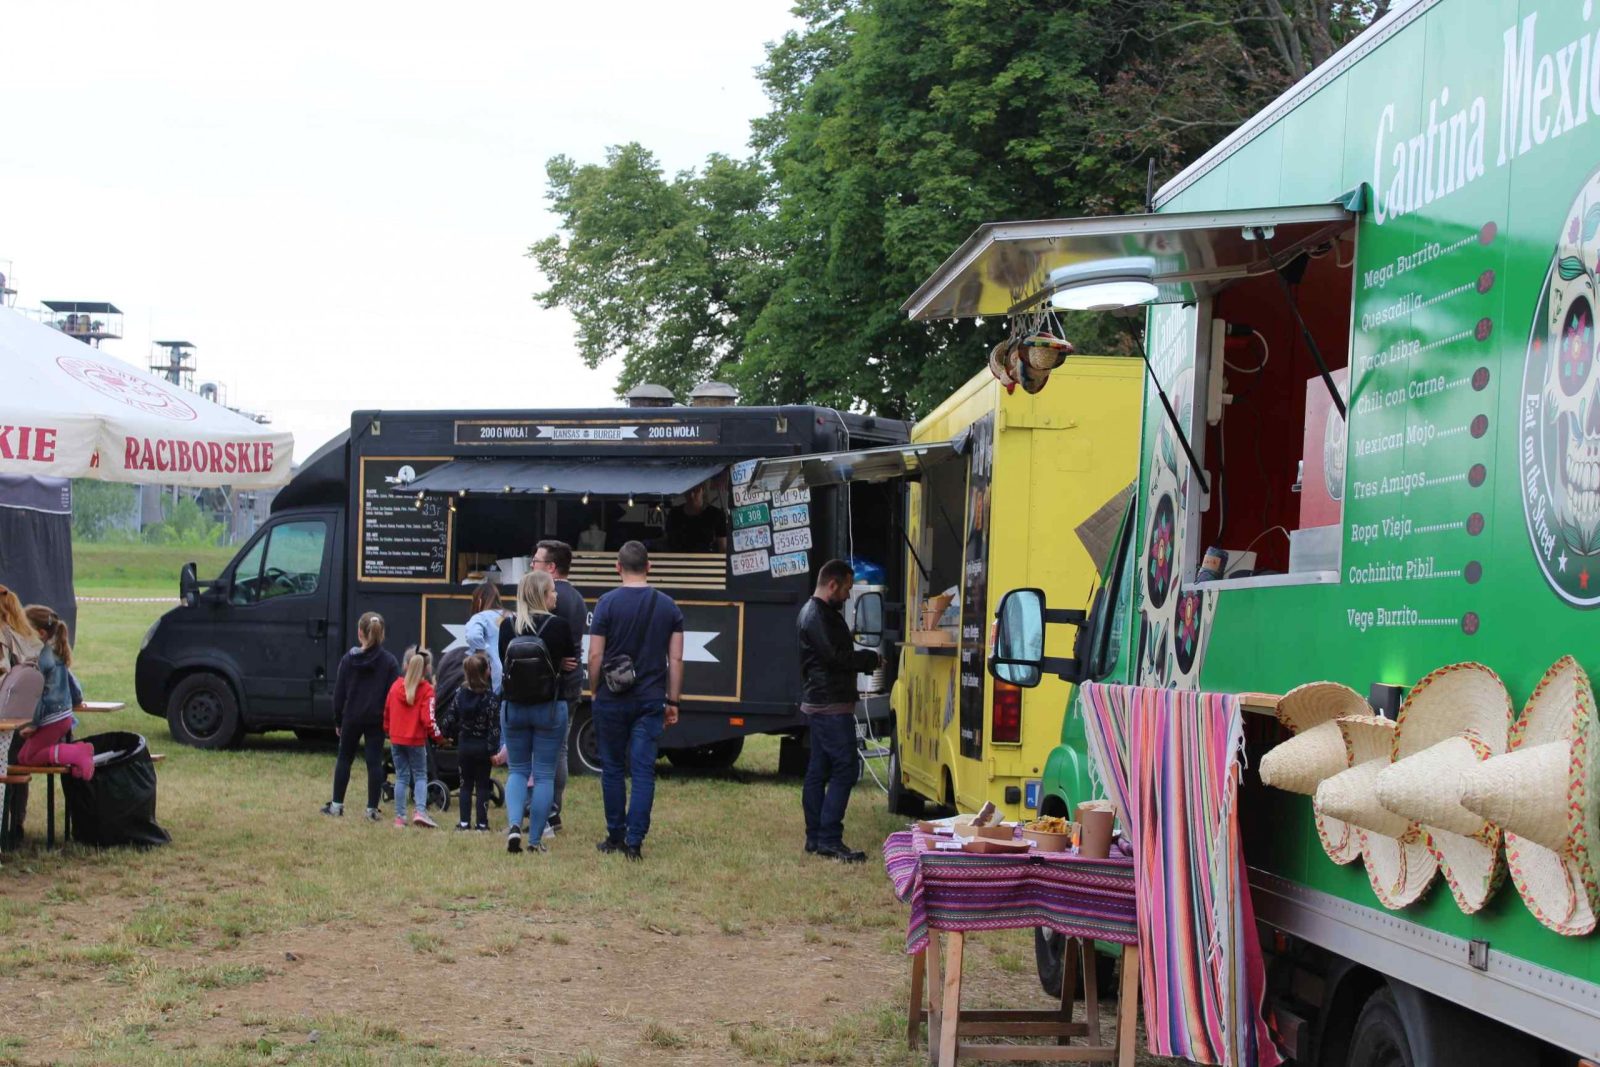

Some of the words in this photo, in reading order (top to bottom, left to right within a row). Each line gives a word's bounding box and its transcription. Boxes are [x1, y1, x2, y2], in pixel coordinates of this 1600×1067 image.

[1373, 86, 1486, 225] Cantina
[1363, 263, 1394, 290] Mega
[1397, 241, 1441, 275] Burrito
[1361, 291, 1423, 333] Quesadilla
[1359, 351, 1387, 373] Taco
[1389, 338, 1420, 362] Libre
[1357, 389, 1383, 415] Chili
[1385, 388, 1406, 407] con
[1408, 375, 1445, 399] Carne
[1524, 393, 1540, 431] Eat
[480, 426, 496, 438] 200
[553, 429, 581, 440] KANSAS
[593, 429, 622, 440] BURGER
[648, 426, 664, 438] 200
[665, 426, 672, 438] G
[1355, 432, 1403, 457] Mexican
[1406, 419, 1435, 447] Mojo
[124, 436, 274, 473] RACIBORSKIE
[1524, 436, 1535, 465] on
[1353, 480, 1378, 499] Tres
[1380, 470, 1426, 496] Amigos
[1526, 466, 1541, 504] the
[1351, 523, 1379, 546] Ropa
[1381, 514, 1412, 542] Vieja
[1532, 494, 1556, 561] Street
[1349, 560, 1403, 584] Cochinita
[1405, 556, 1434, 580] Pibil
[1347, 608, 1374, 632] Vege
[1377, 604, 1418, 626] Burrito
